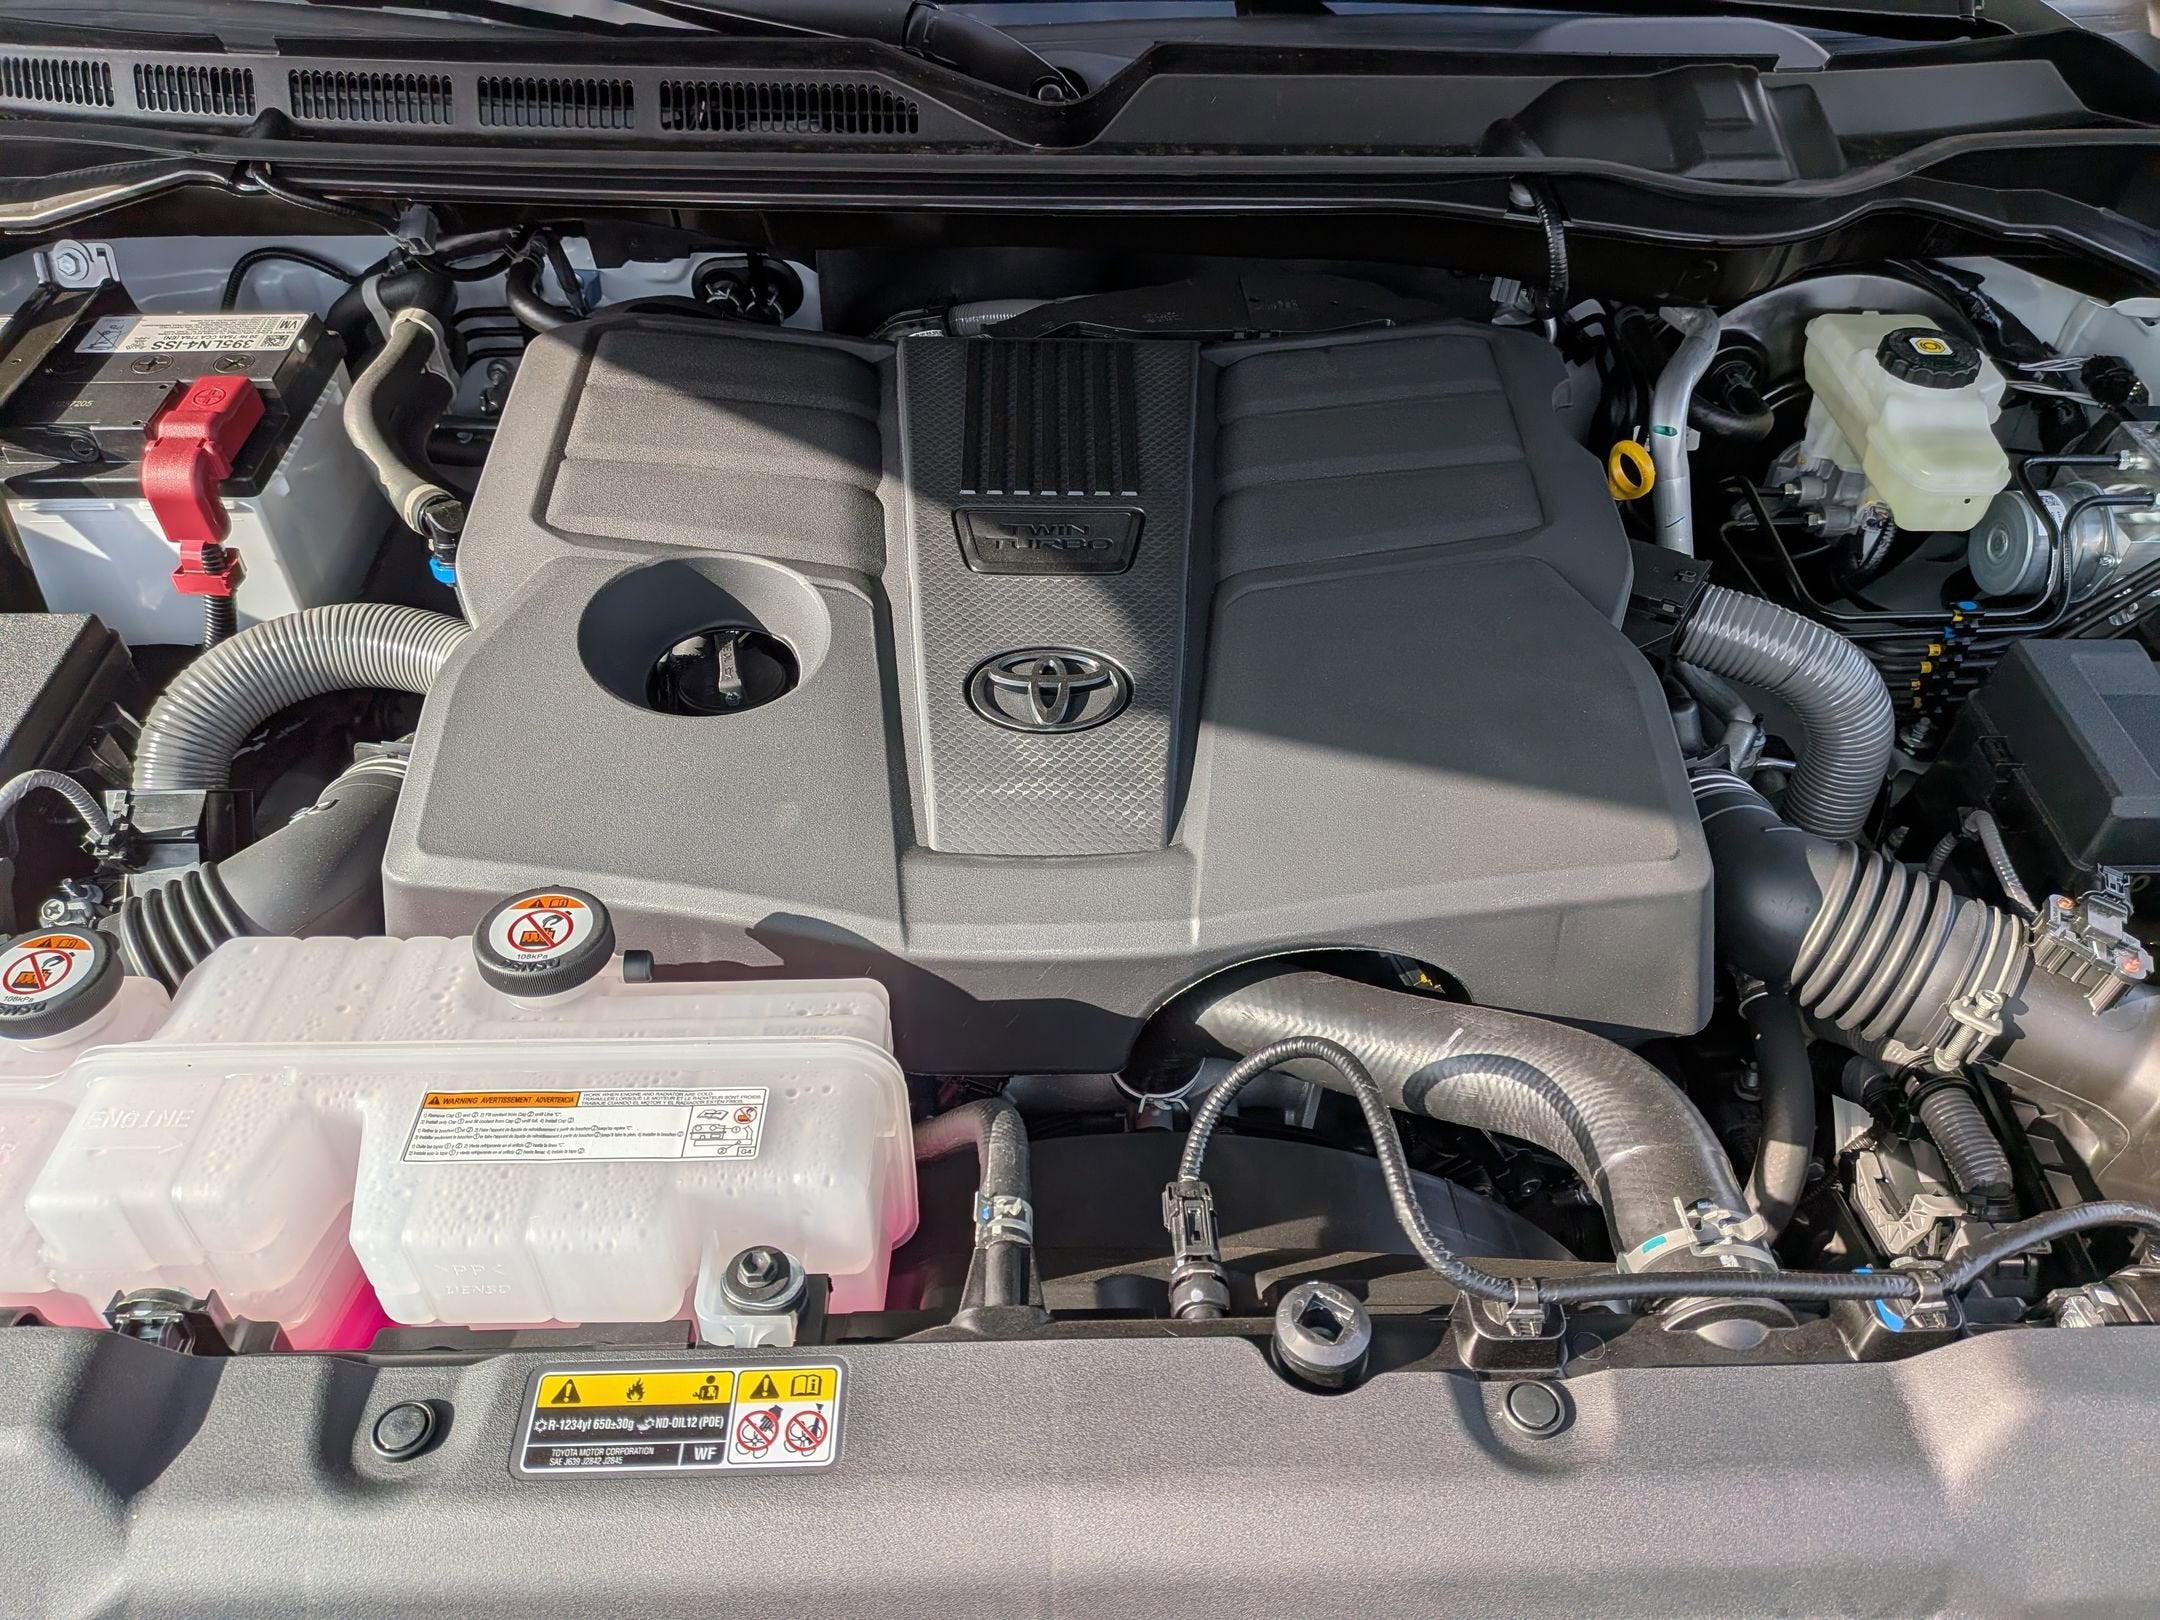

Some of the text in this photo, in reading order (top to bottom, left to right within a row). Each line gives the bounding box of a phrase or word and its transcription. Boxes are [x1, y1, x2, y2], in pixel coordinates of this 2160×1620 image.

[151, 340, 254, 351] 395LN4-ISS
[999, 523, 1091, 537] TWIN
[985, 537, 1115, 550] TURBO
[496, 958, 561, 973] DENSO
[480, 1096, 532, 1104] AVERTISSEMENT
[548, 1416, 724, 1433] R-1234yf 650±30g ND-OIL12 (POE)
[551, 1446, 654, 1457] TOYOTA MOTOR CORPORATION
[694, 1448, 717, 1460] WF
[549, 1457, 563, 1466] SAE
